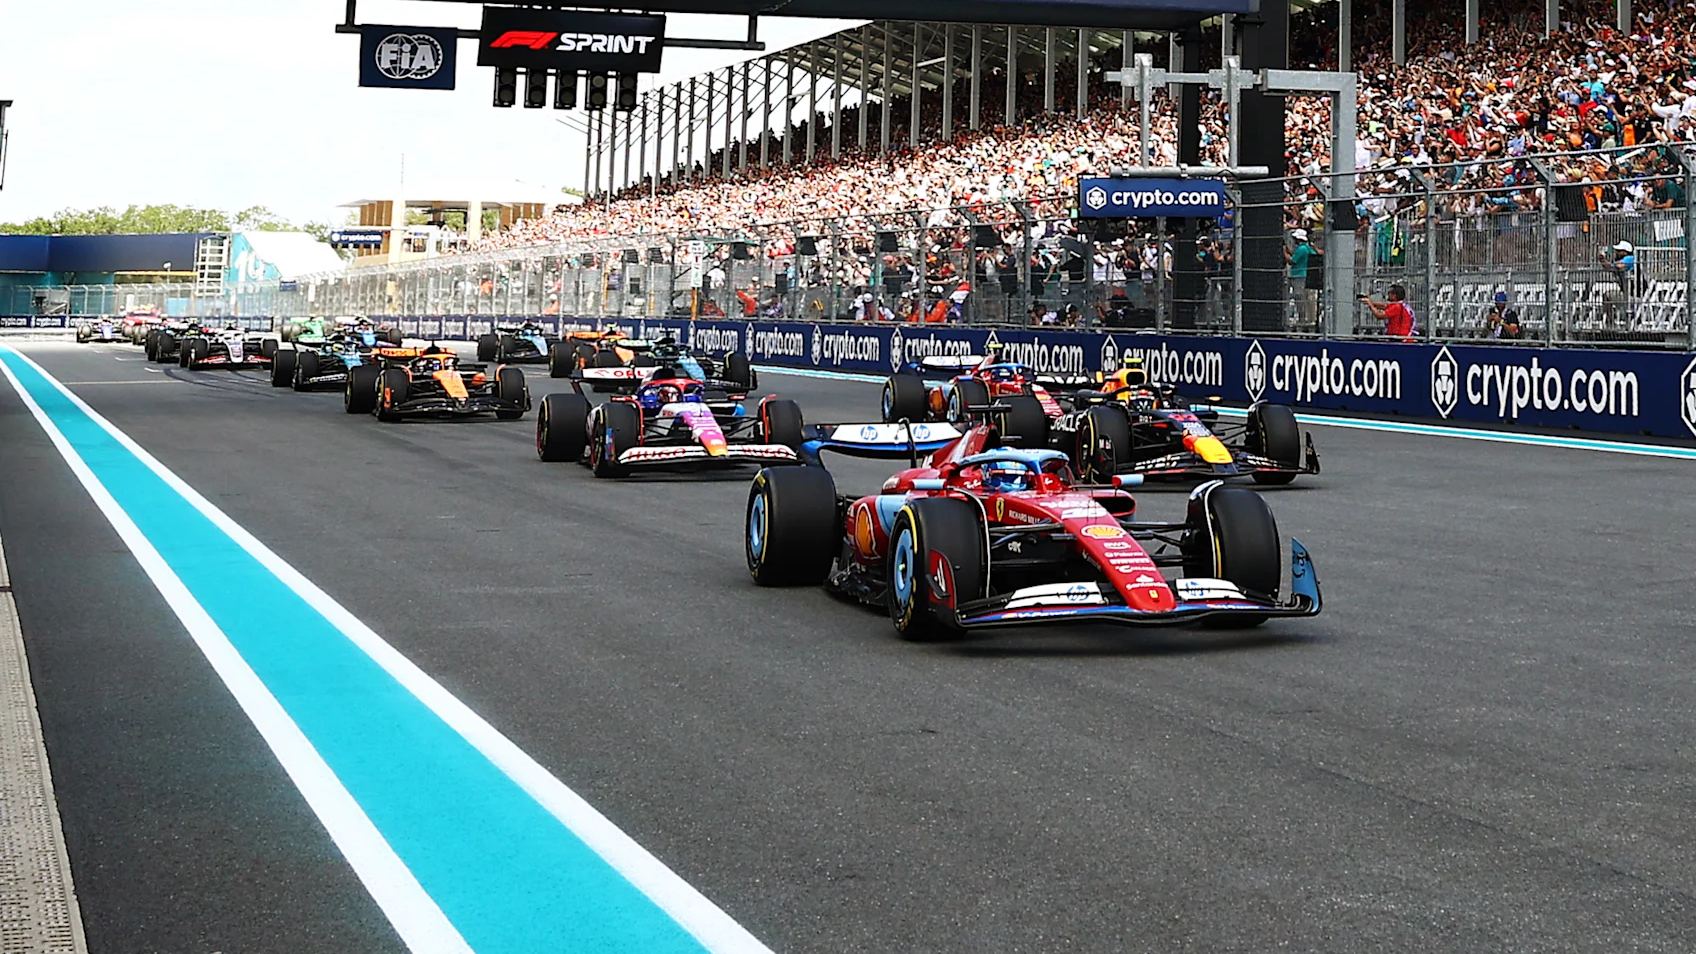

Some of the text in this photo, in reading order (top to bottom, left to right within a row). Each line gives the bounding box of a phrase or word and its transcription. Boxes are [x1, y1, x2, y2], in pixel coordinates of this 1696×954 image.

[555, 32, 656, 54] SPRINT
[1111, 188, 1218, 208] crypto.com
[696, 325, 739, 354] crypto.com
[755, 326, 804, 359] crypto.com
[823, 329, 880, 365] crypto.com
[1272, 345, 1401, 403] crypto.com
[1466, 356, 1639, 418] crypto.com
[1126, 582, 1169, 591] Santander
